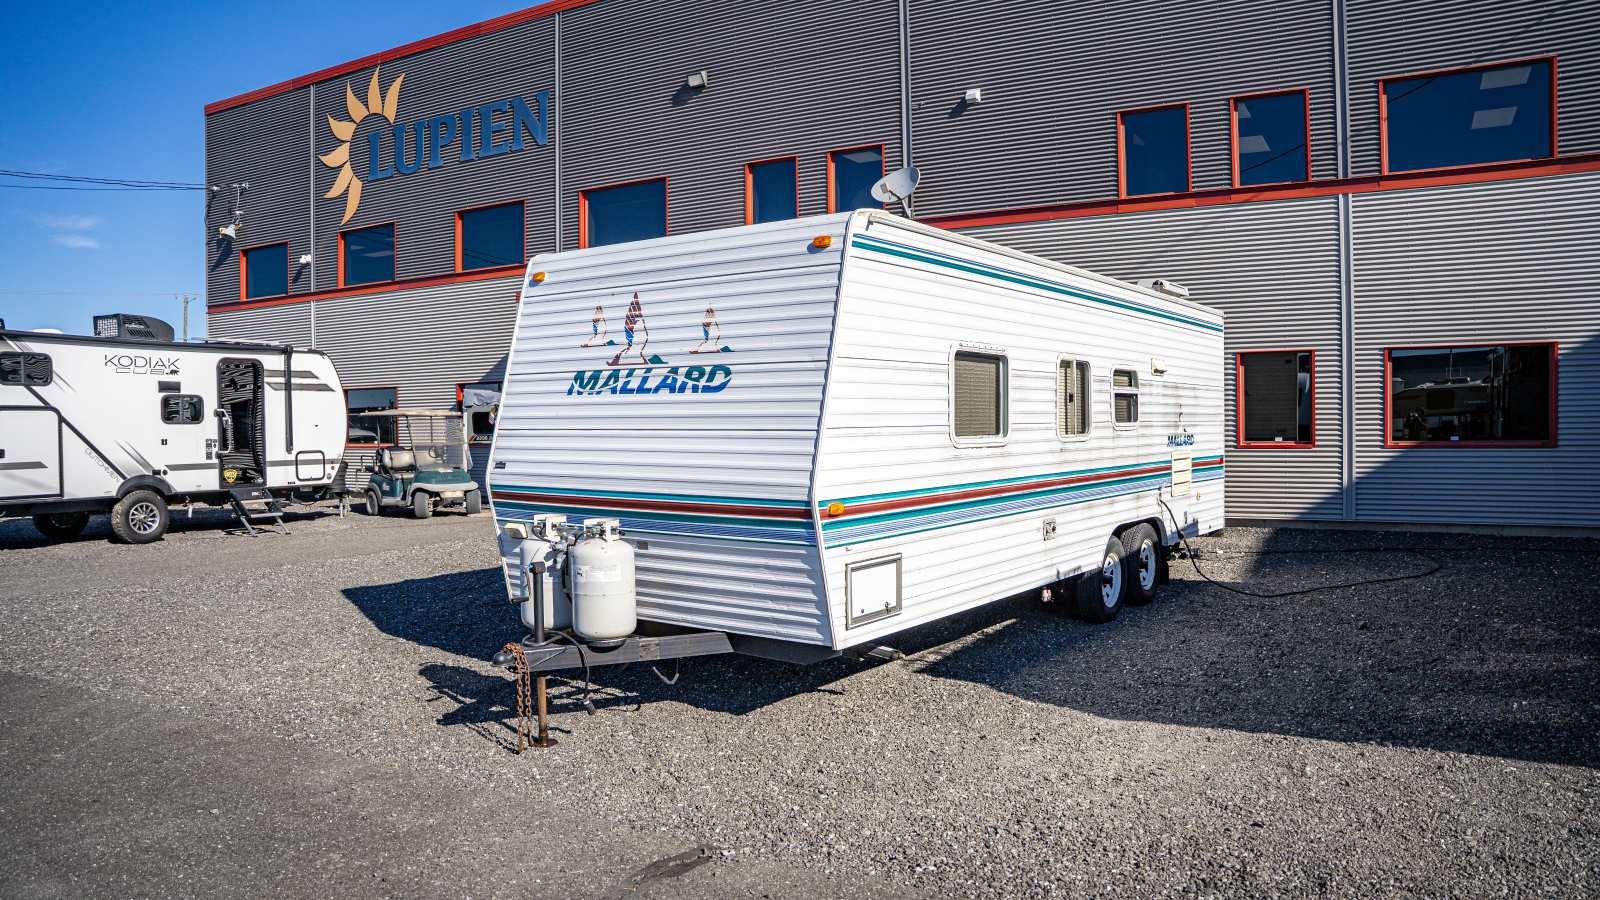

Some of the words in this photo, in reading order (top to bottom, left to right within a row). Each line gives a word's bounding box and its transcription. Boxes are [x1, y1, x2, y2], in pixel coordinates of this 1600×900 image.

[367, 89, 550, 182] LUPIEN
[104, 354, 180, 369] KODIAK
[566, 364, 732, 396] MALLARD
[1167, 434, 1195, 447] MALLARD
